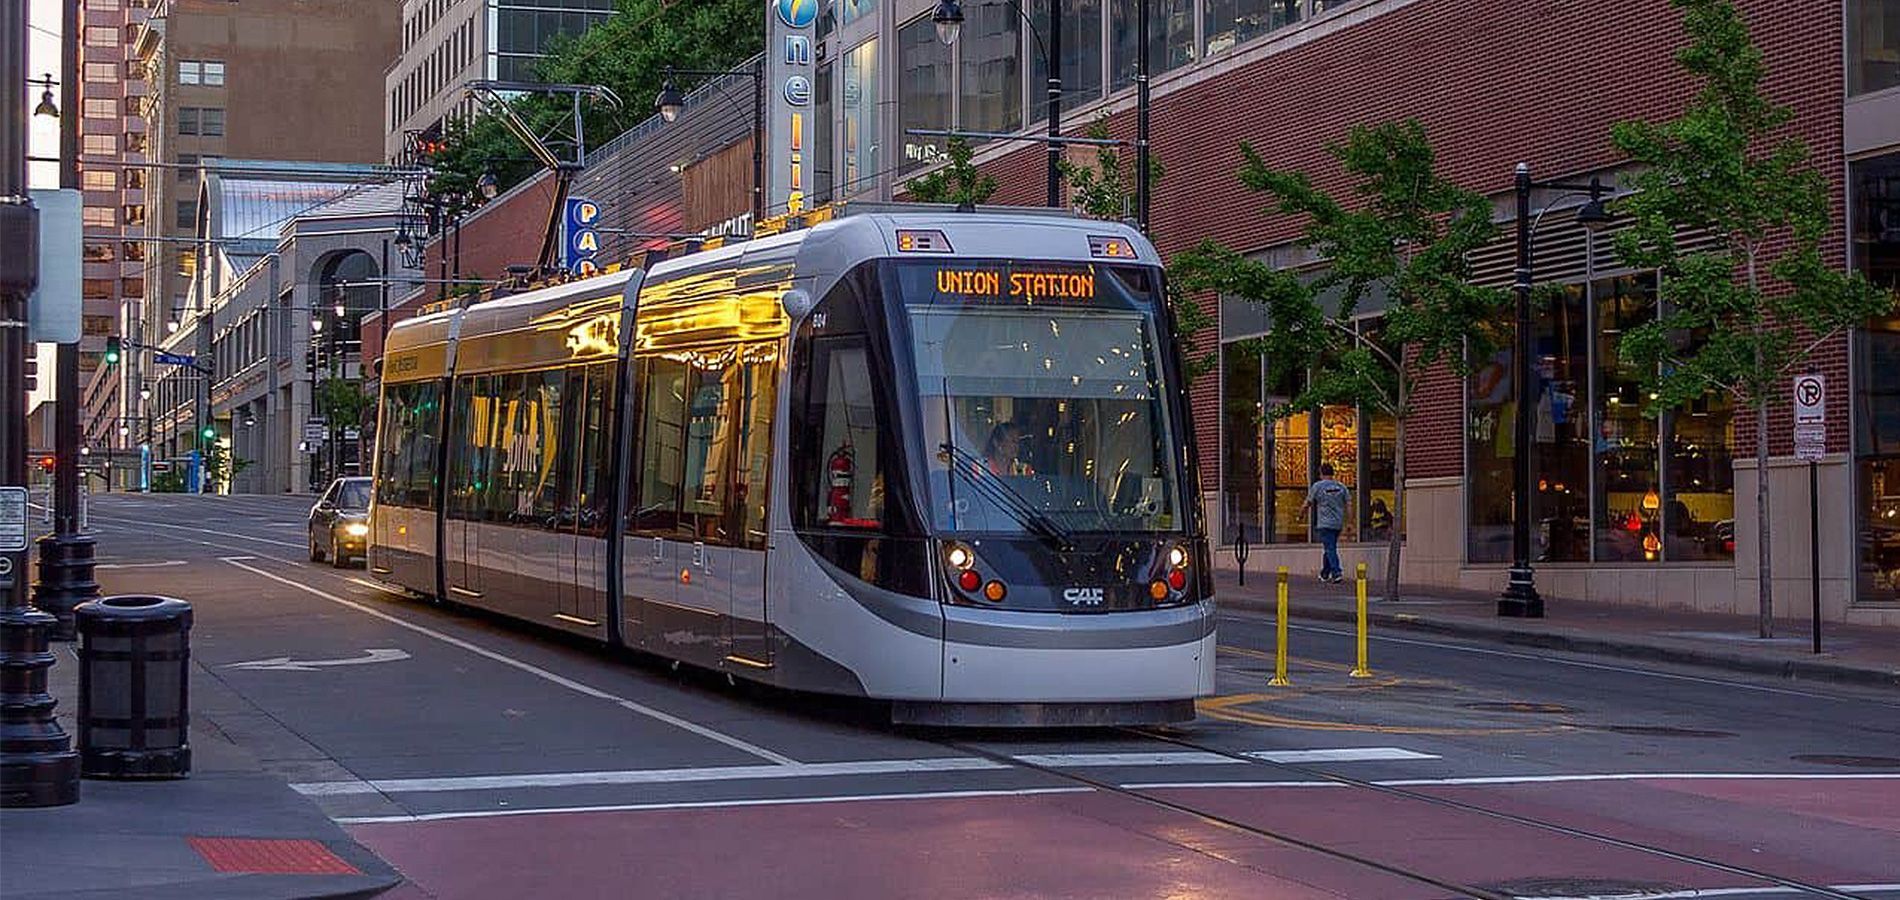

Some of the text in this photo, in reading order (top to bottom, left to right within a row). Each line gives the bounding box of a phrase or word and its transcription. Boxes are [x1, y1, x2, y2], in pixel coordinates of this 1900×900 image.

[937, 270, 1094, 298] UNION STATION
[1063, 588, 1104, 605] CAF
